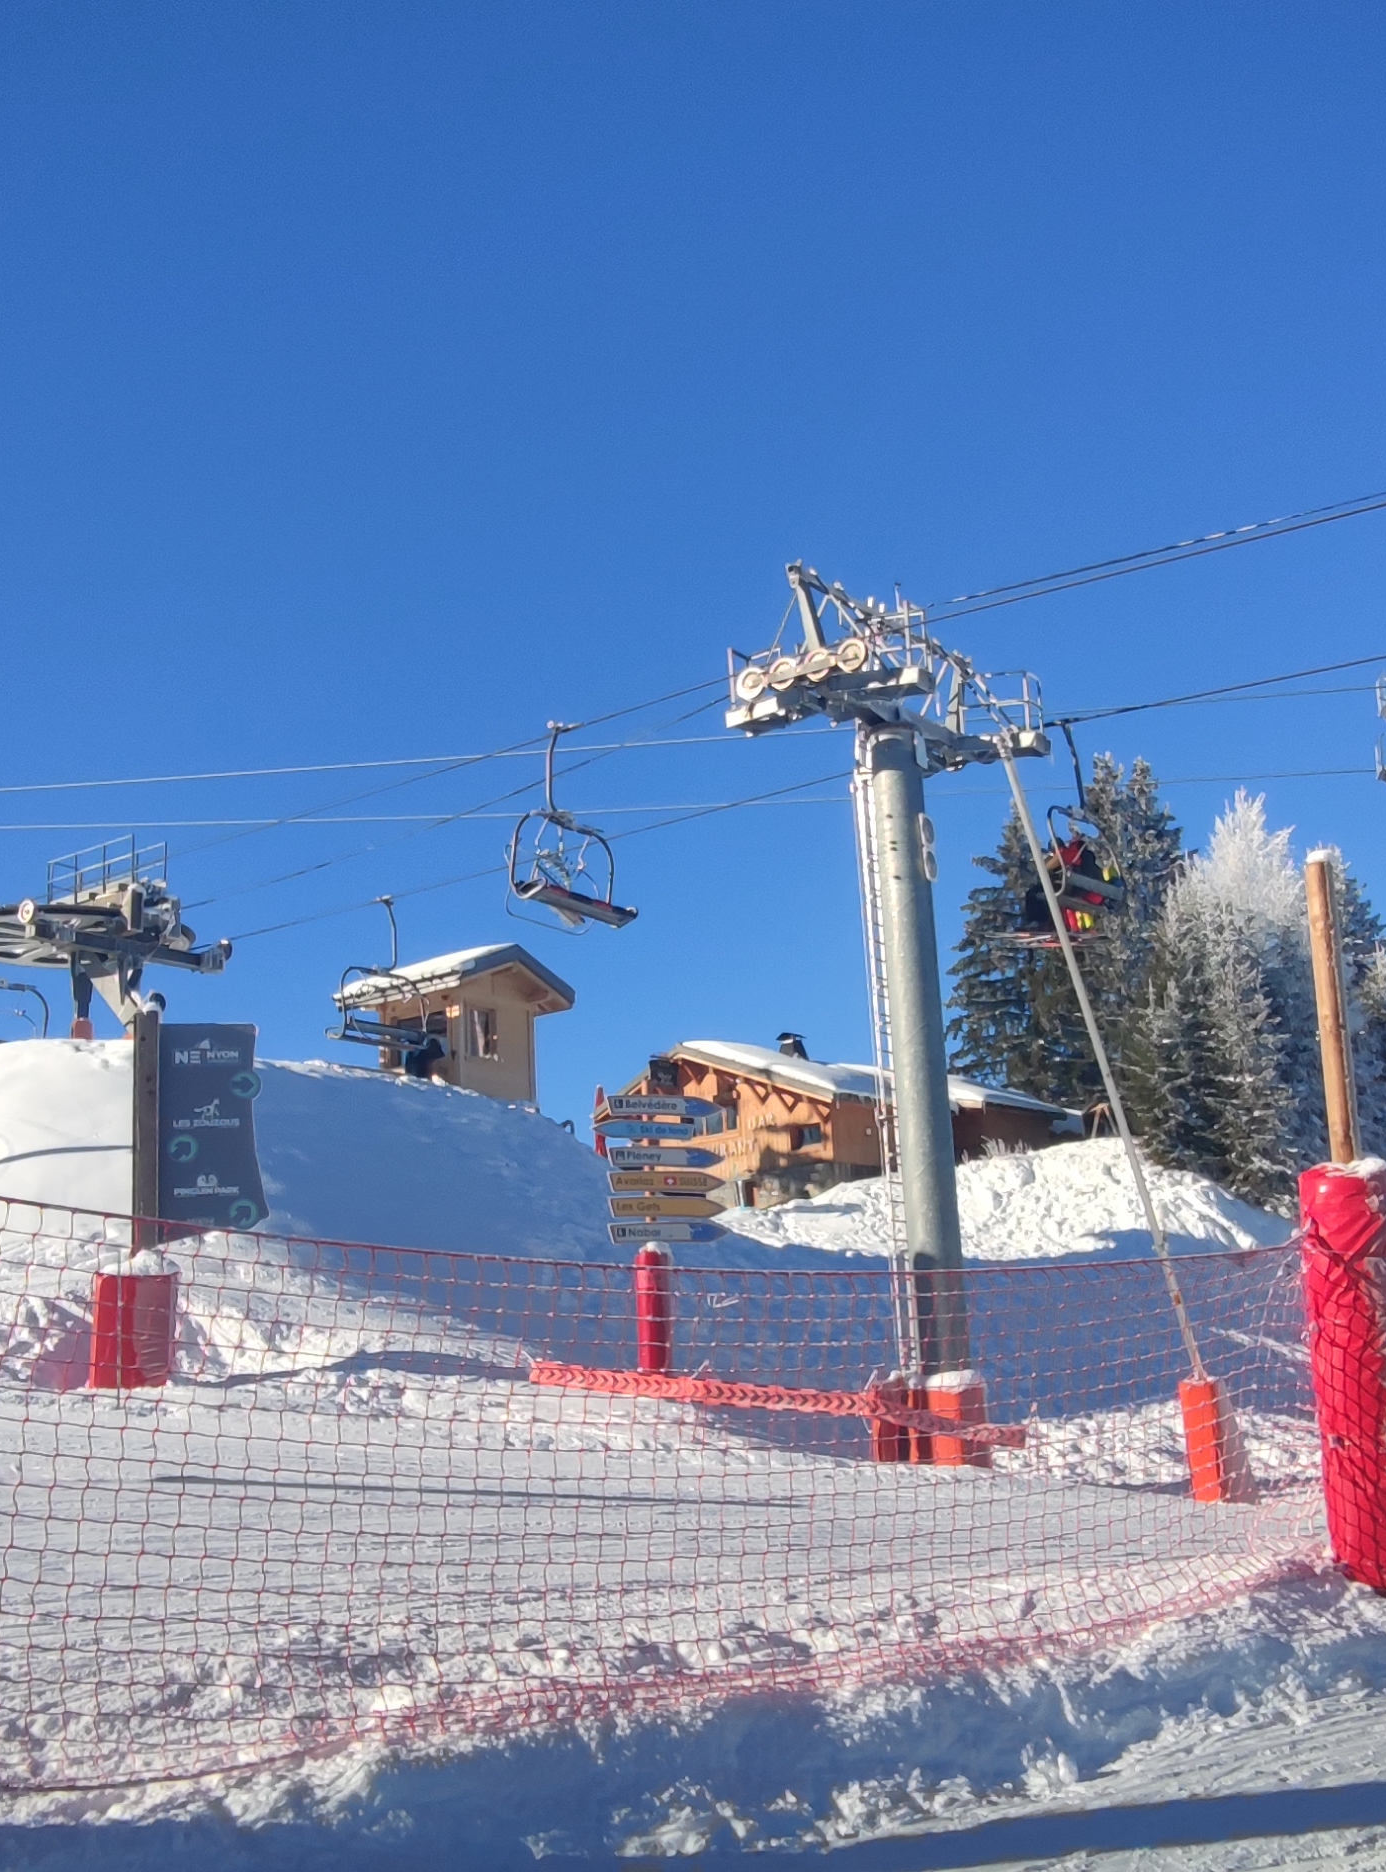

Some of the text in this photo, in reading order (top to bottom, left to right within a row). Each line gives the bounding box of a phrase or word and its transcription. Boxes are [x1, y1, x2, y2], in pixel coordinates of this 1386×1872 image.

[625, 1097, 678, 1111] Belvédère
[616, 1201, 661, 1211] Les Gets
